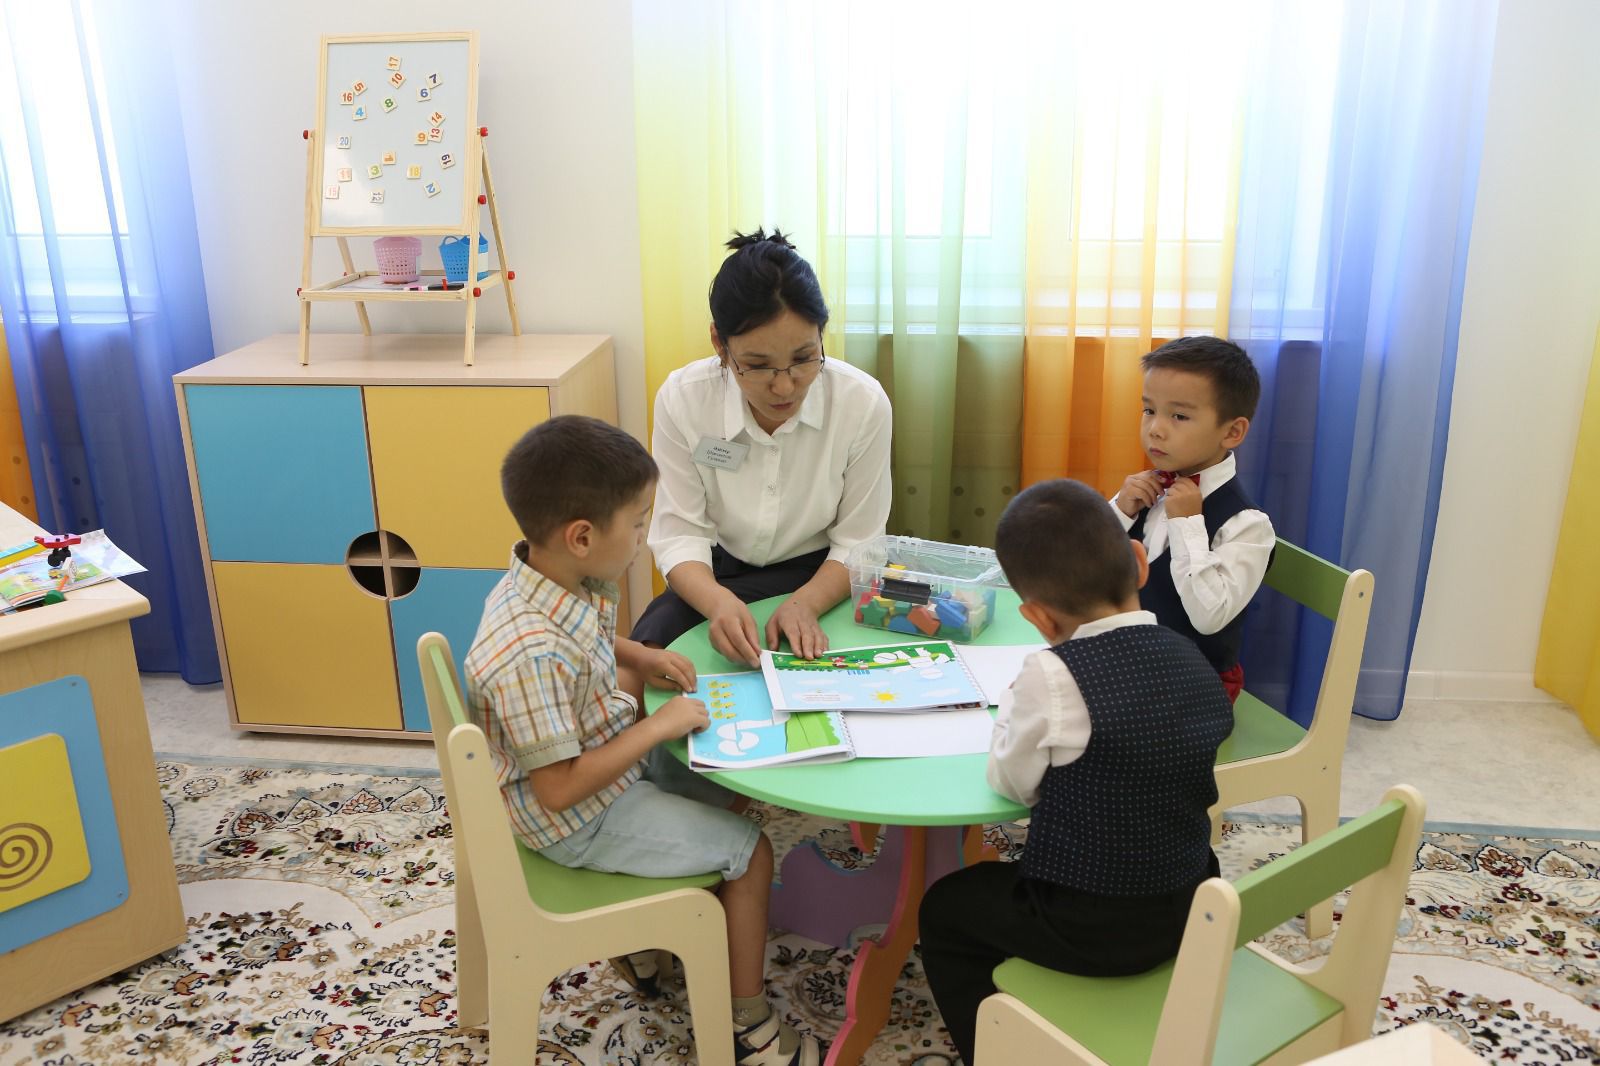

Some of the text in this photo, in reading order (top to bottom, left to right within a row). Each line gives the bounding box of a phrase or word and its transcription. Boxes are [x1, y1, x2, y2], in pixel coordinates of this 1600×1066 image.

[388, 56, 399, 67] 17
[391, 73, 403, 84] 10
[428, 73, 437, 84] 7
[354, 82, 364, 92] 5
[342, 92, 353, 102] 16
[420, 88, 429, 98] 6
[384, 98, 394, 108] 8
[355, 107, 364, 117] 4
[431, 112, 442, 123] 14
[417, 132, 426, 142] 9
[430, 128, 440, 139] 13
[339, 136, 349, 146] 20
[441, 154, 451, 165] 19
[370, 165, 380, 176] 3
[426, 182, 436, 194] 2
